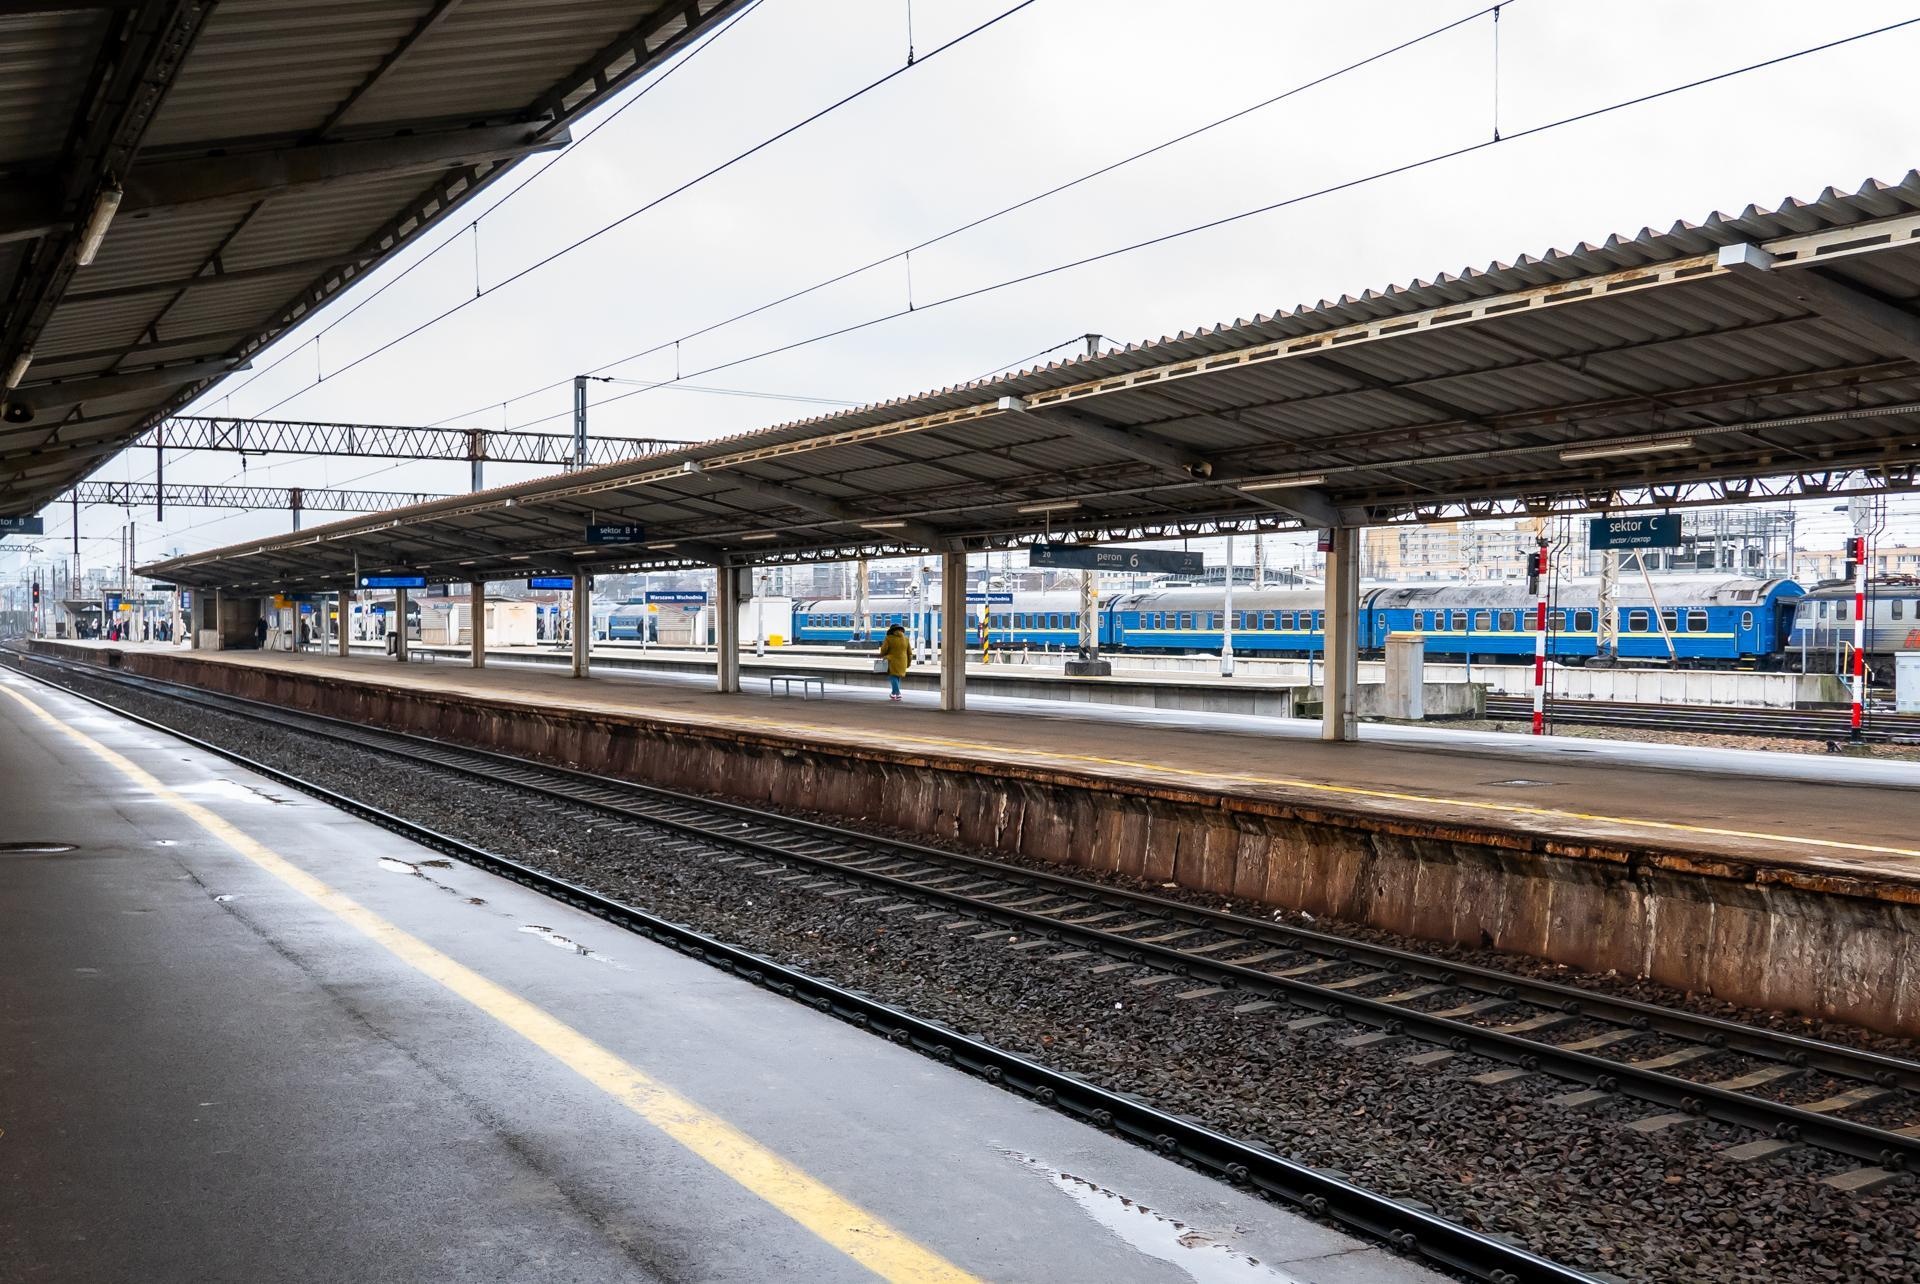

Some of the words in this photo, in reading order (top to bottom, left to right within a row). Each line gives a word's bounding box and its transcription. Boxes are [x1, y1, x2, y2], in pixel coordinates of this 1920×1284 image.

[0, 518, 12, 526] tor
[19, 518, 25, 526] B
[1609, 520, 1642, 533] sektor
[1650, 517, 1658, 530] C
[600, 526, 621, 534] sektor
[625, 526, 631, 534] B
[1097, 553, 1122, 562] peron
[1130, 553, 1139, 568] 6
